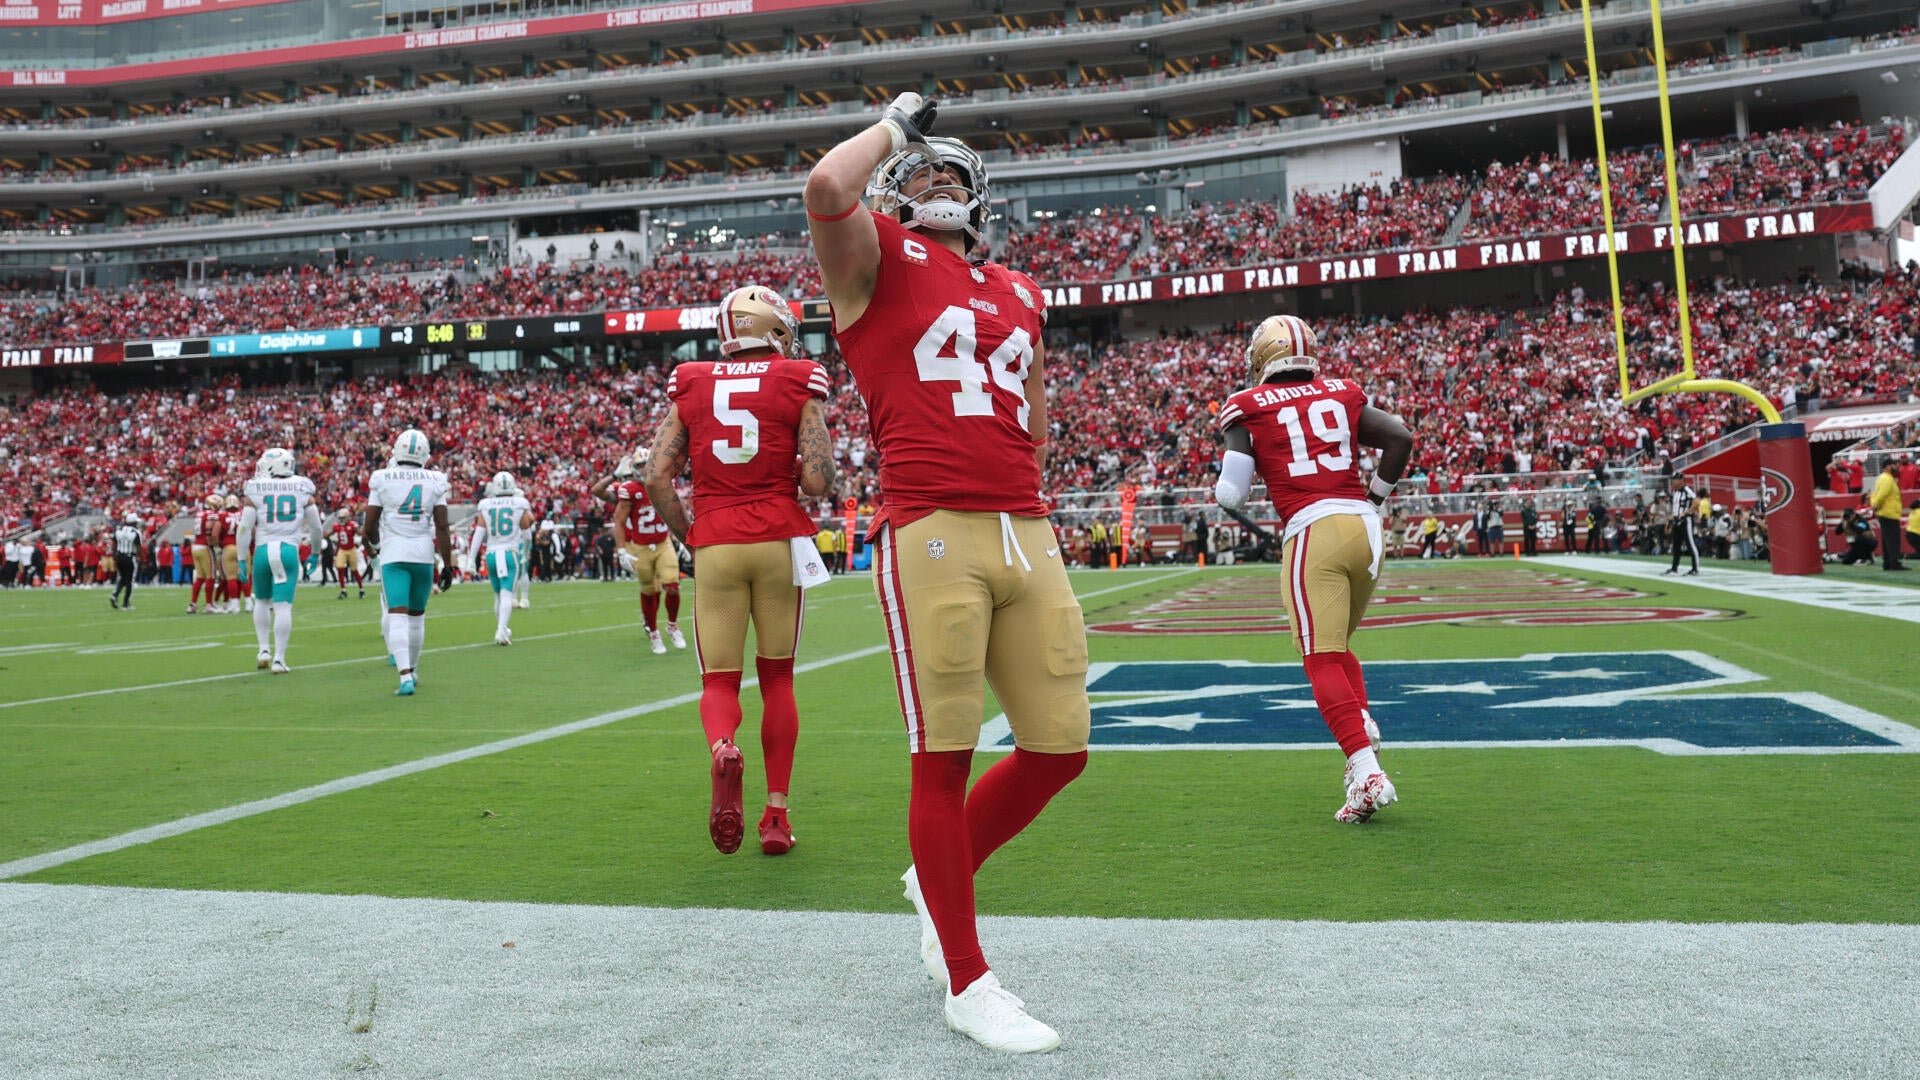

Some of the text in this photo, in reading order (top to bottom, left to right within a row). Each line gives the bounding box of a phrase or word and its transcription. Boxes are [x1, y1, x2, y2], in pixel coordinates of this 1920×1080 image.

[57, 6, 82, 19] LOTT
[440, 28, 477, 45] DIVISION
[478, 22, 528, 41] CHAMPIONS
[13, 71, 66, 85] BILL WALSH
[903, 239, 928, 260] C
[1046, 286, 1082, 307] RAN
[1101, 280, 1153, 304] FRAN
[1171, 273, 1224, 297] FRAN
[1243, 265, 1299, 289] FRAN
[1319, 256, 1377, 282] FRAN
[1398, 249, 1457, 274] FRAN
[1480, 240, 1541, 265] FRAN
[1565, 231, 1628, 257] FRAN
[1745, 211, 1815, 239] FRAN
[625, 313, 645, 331] 27
[259, 334, 327, 350] Dolphins
[404, 327, 413, 345] 3
[427, 324, 454, 343] 5:46
[2, 346, 94, 367] FRAN FRAN
[711, 361, 771, 375] EVANS
[912, 304, 1034, 433] 44
[1253, 379, 1347, 407] SAMUEL SR
[712, 378, 760, 465] 5
[1276, 398, 1353, 478] 19
[384, 471, 441, 482] MARSHALL
[255, 483, 305, 493] RODRIGUEZ
[262, 494, 297, 524] 10
[398, 484, 424, 522] 4
[488, 507, 513, 536] 16
[1535, 520, 1558, 539] 35
